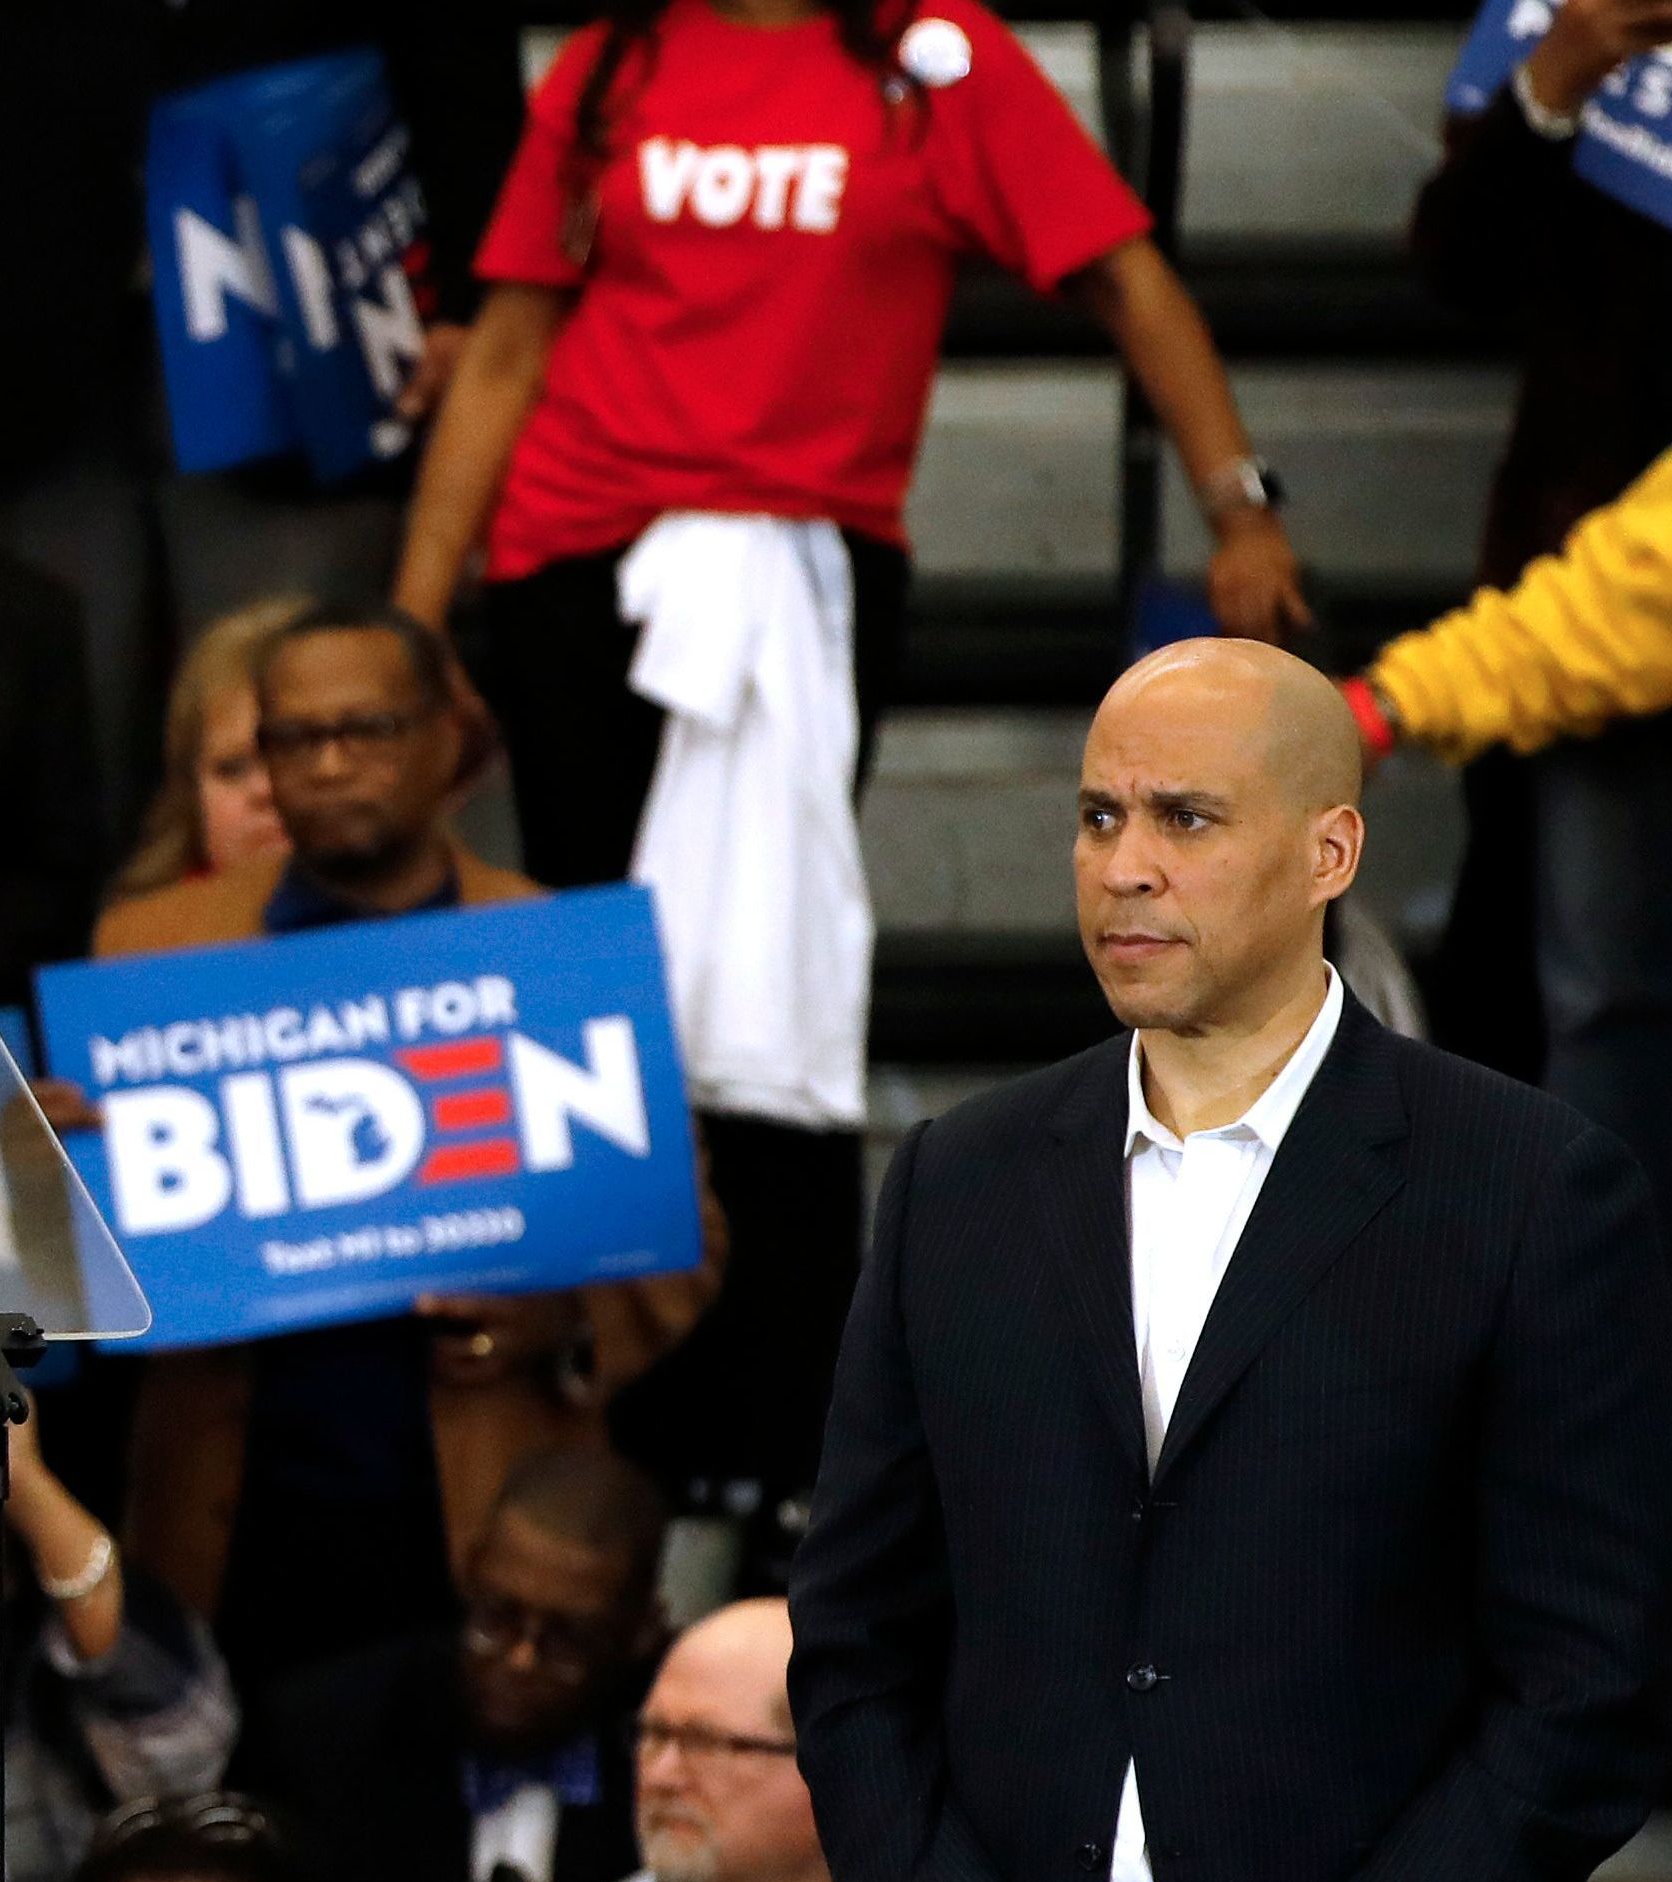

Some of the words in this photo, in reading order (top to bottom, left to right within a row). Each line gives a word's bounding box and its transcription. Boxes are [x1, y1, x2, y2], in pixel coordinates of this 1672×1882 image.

[638, 136, 851, 234] VOTE
[89, 996, 391, 1087] MICHIGAN
[394, 974, 517, 1040] FOR
[101, 1013, 652, 1238] BIDEN
